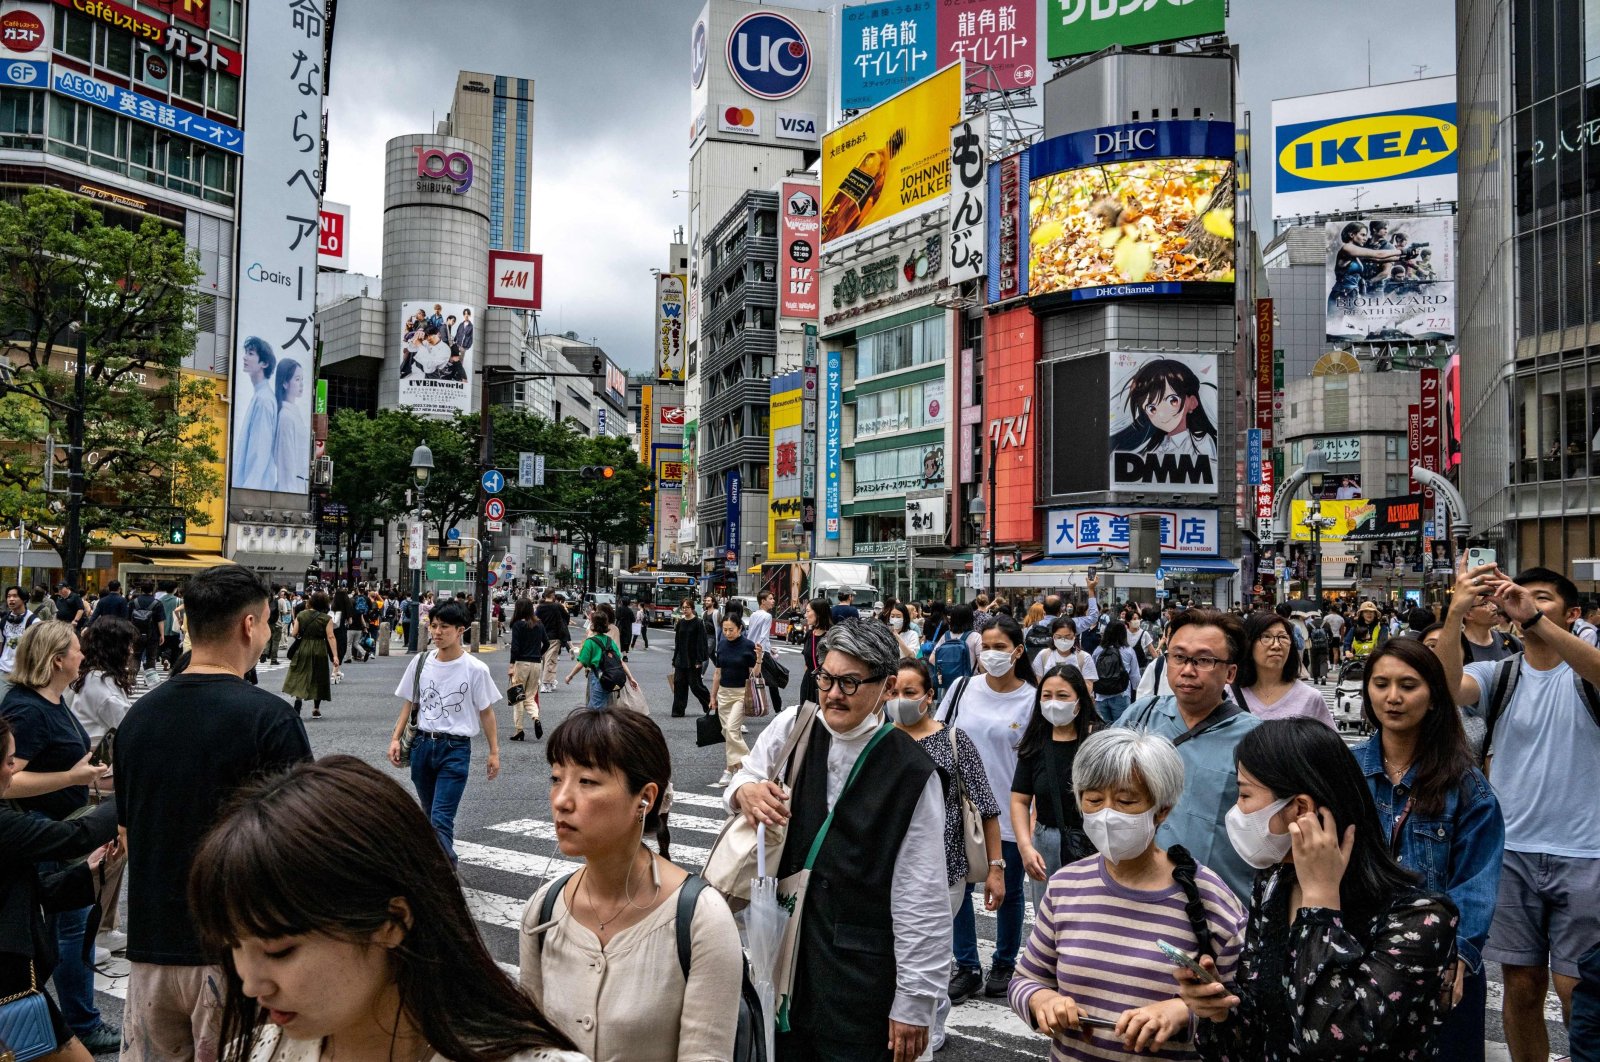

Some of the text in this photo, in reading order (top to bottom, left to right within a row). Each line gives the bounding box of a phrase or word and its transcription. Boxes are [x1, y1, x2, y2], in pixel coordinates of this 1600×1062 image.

[4, 29, 40, 41] ガスト
[861, 20, 918, 50] 龍角散
[958, 5, 1016, 37] 龍角散
[165, 28, 229, 71] ガスト
[950, 35, 1027, 62] ダイレクト
[11, 66, 33, 80] 6F
[854, 48, 927, 78] ダイレクト
[462, 85, 490, 94] INDIGO
[63, 73, 241, 146] AEON 英会話 イーオン
[778, 117, 815, 134] VISA
[1093, 129, 1156, 156] DHC
[1295, 126, 1450, 170] IKEA
[412, 145, 474, 193] 109
[416, 181, 452, 194] SHIBUYA
[952, 122, 984, 274] もんじゃ
[260, 270, 292, 287] pairs
[500, 269, 530, 290] H&M
[1096, 285, 1155, 297] DHC Channel
[1336, 295, 1448, 307] BIOHAZARD
[1344, 306, 1436, 316] DEATH ISLAND
[1427, 317, 1446, 328] 7.7
[1259, 302, 1271, 383] クスリのことなら
[828, 372, 839, 470] サマーフルーツギフト
[989, 395, 1032, 456] クスリ
[1421, 377, 1438, 447] カラオケ
[776, 440, 798, 478] 薬
[1114, 452, 1214, 484] DMM
[1324, 450, 1360, 460] リニック
